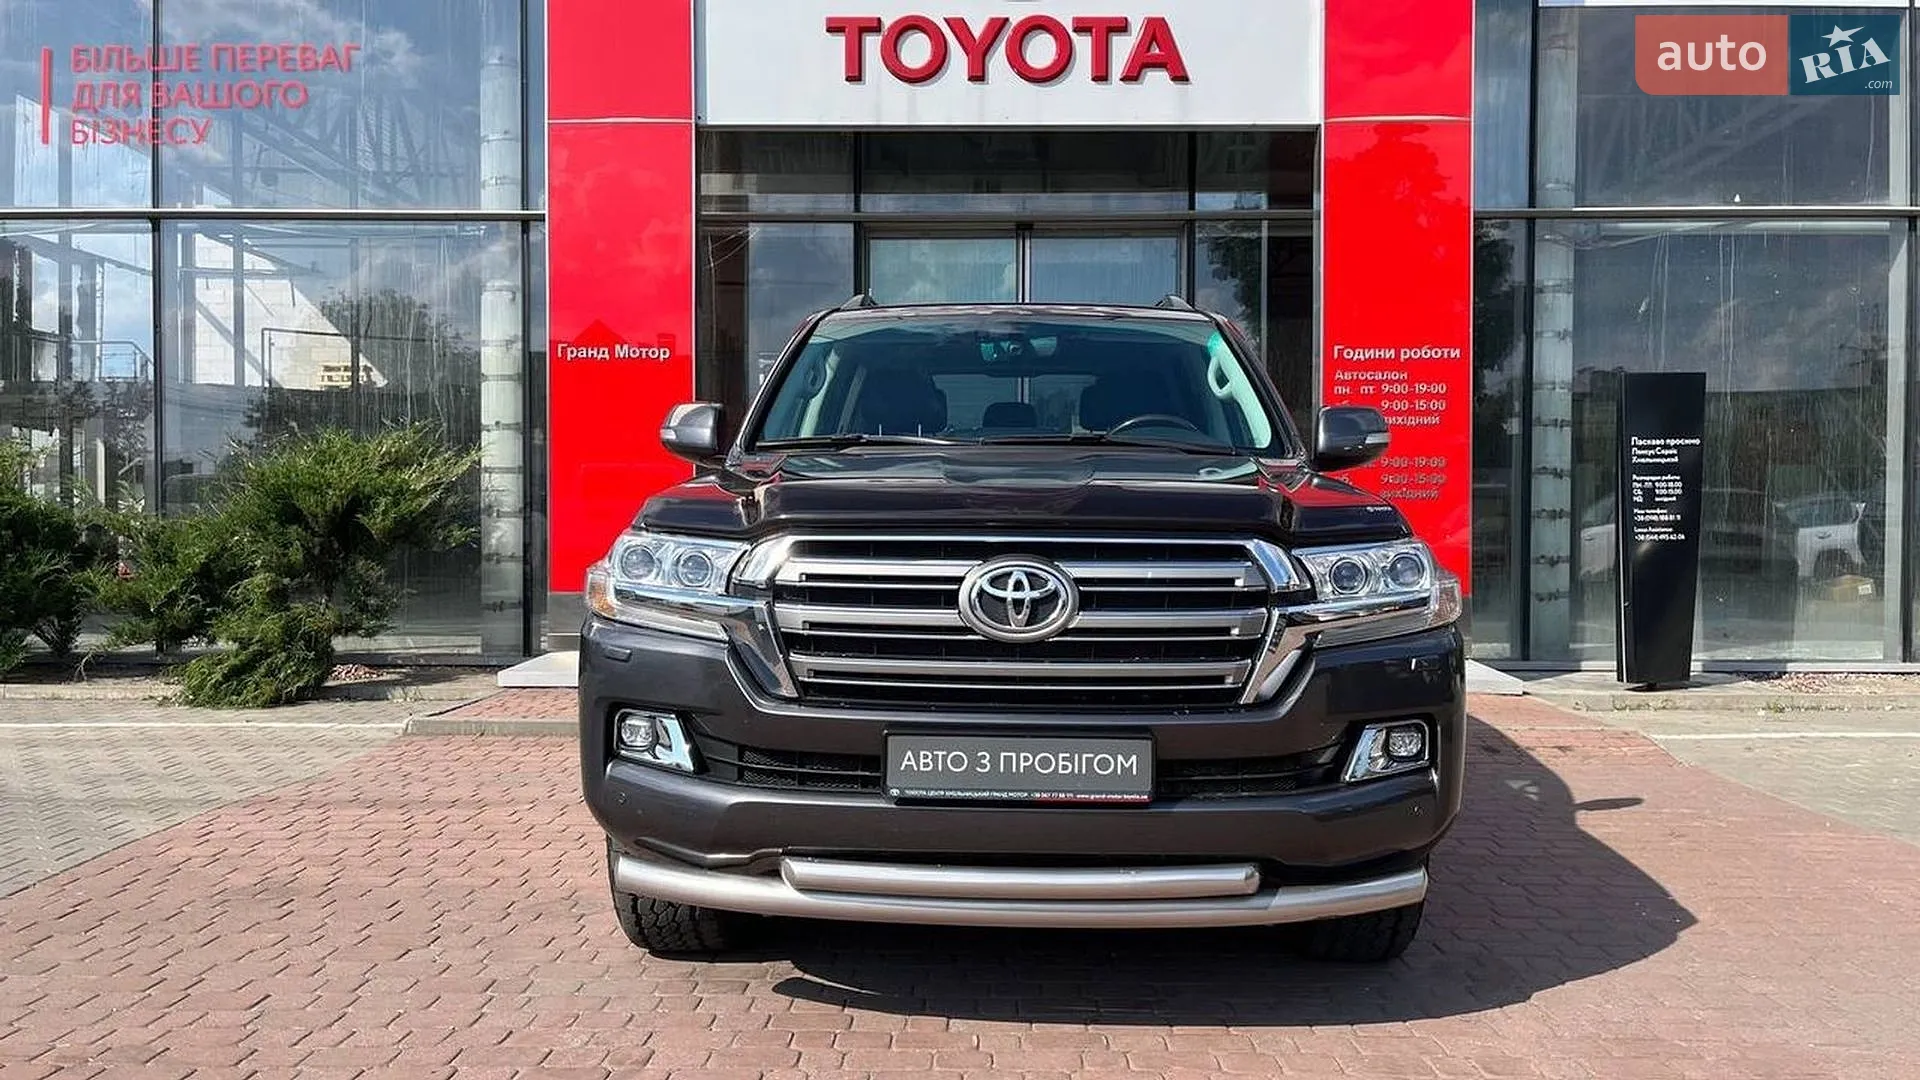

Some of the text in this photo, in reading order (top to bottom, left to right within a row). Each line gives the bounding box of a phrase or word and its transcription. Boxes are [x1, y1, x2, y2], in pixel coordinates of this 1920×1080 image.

[71, 44, 362, 73] БІЛЬШЕ ПЕРЕВАГ
[825, 14, 1191, 84] TOYOTA
[72, 80, 309, 112] ДЛЯ ВАШОГО
[71, 117, 213, 145] БІЗНЕСУ
[557, 343, 671, 362] Гранд Мотор
[1333, 345, 1461, 362] Години роботи
[1335, 370, 1408, 381] Автосалон
[900, 750, 1138, 776] АВТО З ПРОБІГОМ
